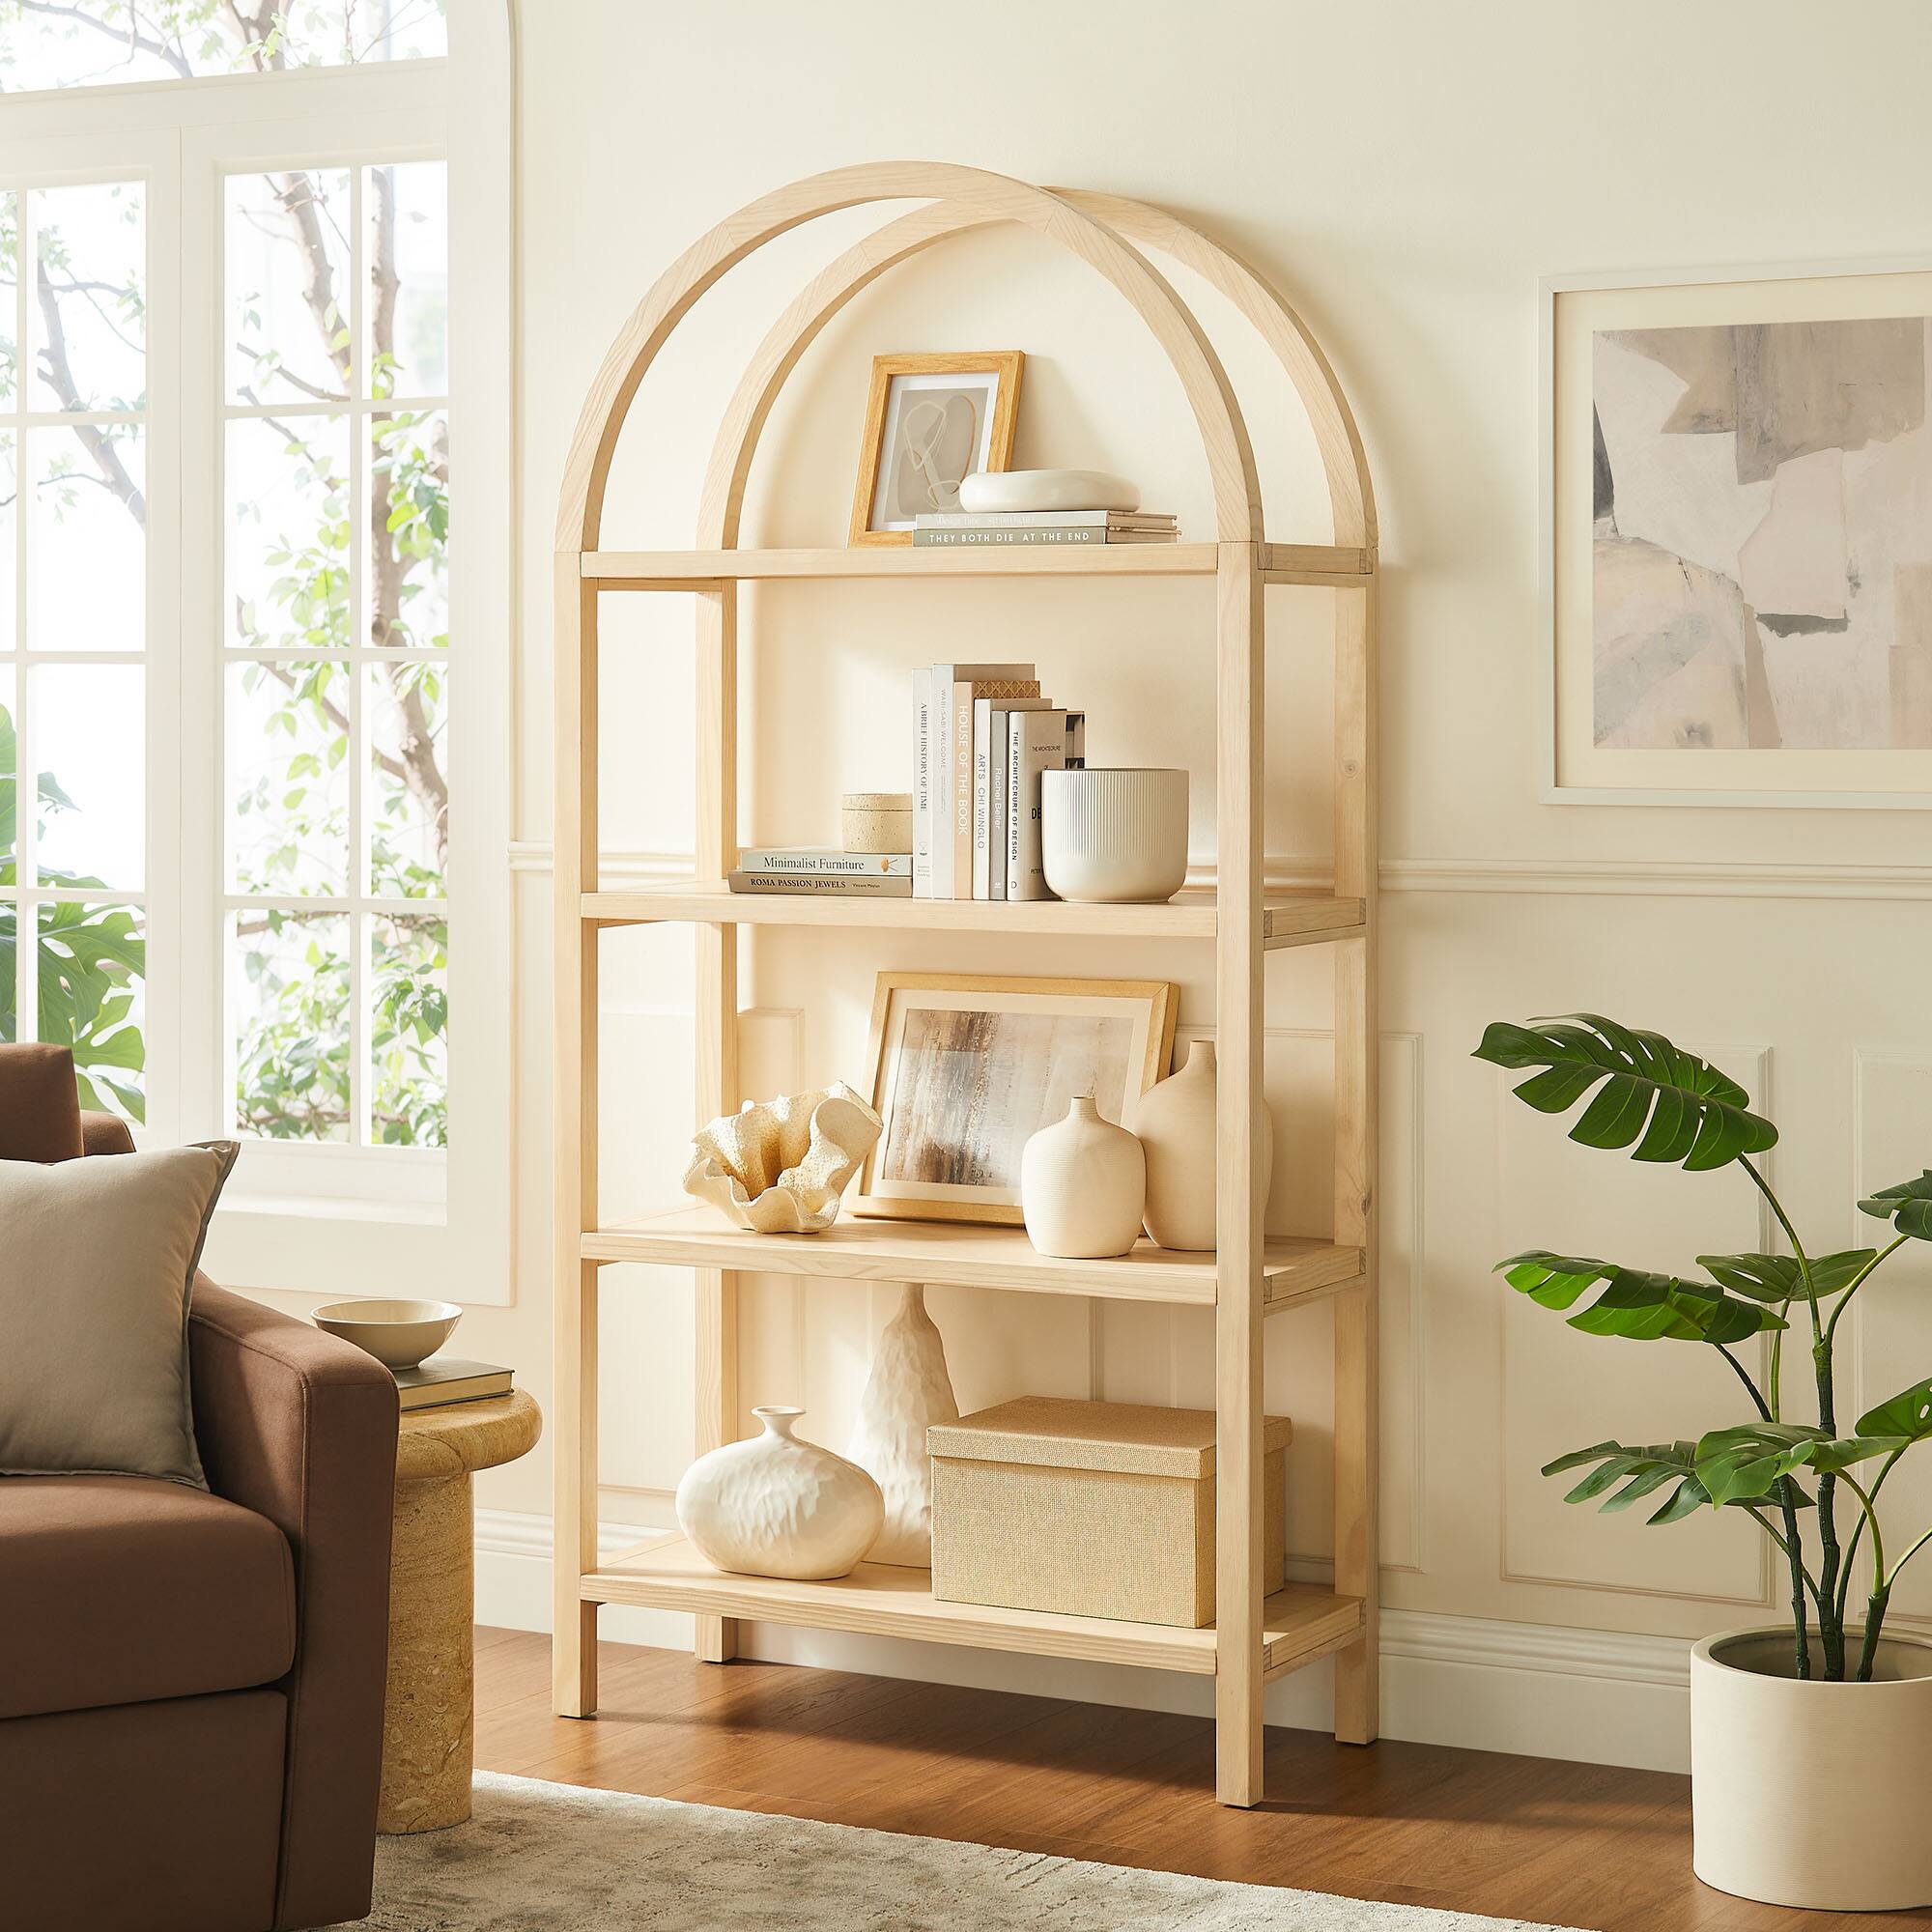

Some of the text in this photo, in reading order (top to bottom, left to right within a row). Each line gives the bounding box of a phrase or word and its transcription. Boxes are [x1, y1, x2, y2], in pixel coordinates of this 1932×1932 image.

[928, 531, 1090, 543] THEY BOTH DIE AT THE END
[958, 706, 968, 835] HOUSE OF THE BOOK
[921, 777, 927, 788] OF
[1012, 816, 1018, 828] OF
[764, 857, 865, 870] Minimalist Furniture
